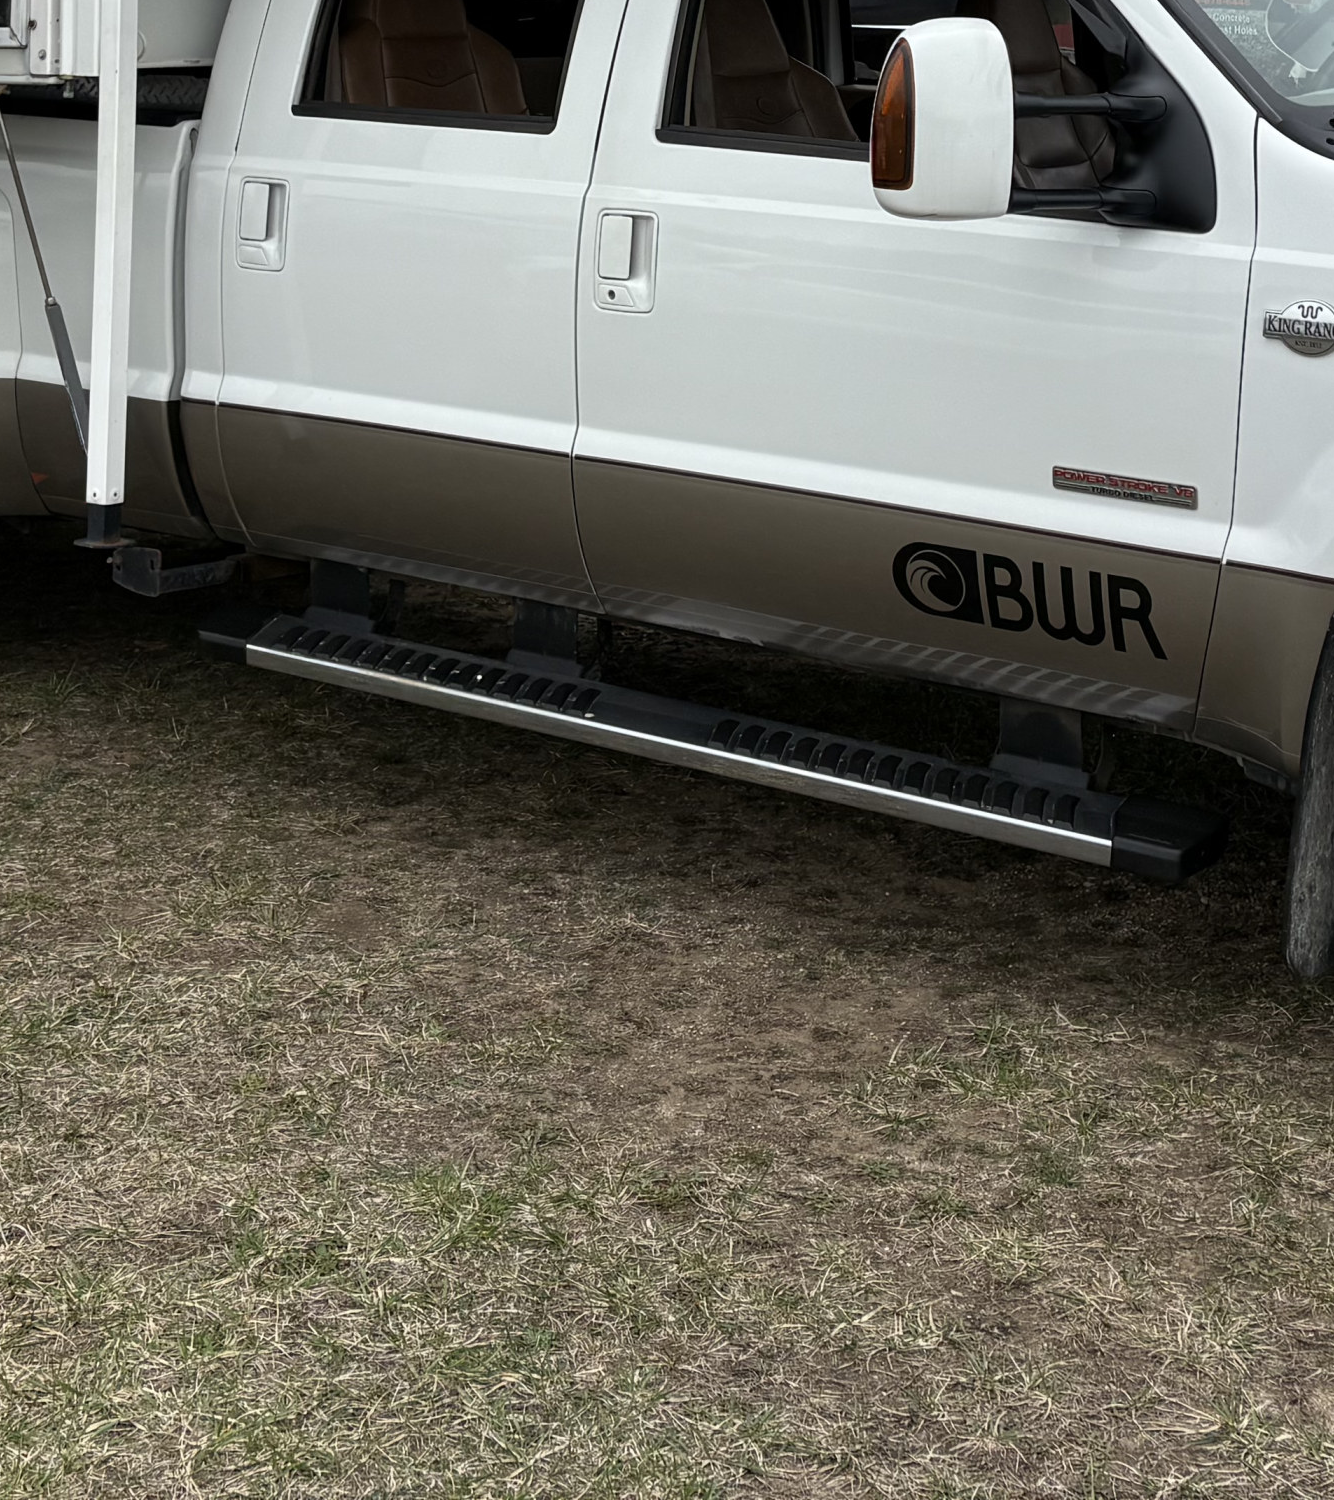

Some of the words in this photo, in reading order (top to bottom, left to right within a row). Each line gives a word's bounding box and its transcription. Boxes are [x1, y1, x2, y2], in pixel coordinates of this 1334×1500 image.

[1267, 314, 1301, 337] KING
[1054, 468, 1106, 484] POWER
[1108, 475, 1168, 494] STROKE
[1173, 485, 1195, 497] V8
[1090, 486, 1121, 497] TURBO
[1123, 490, 1154, 501] DIESEL
[982, 551, 1167, 660] BWR
